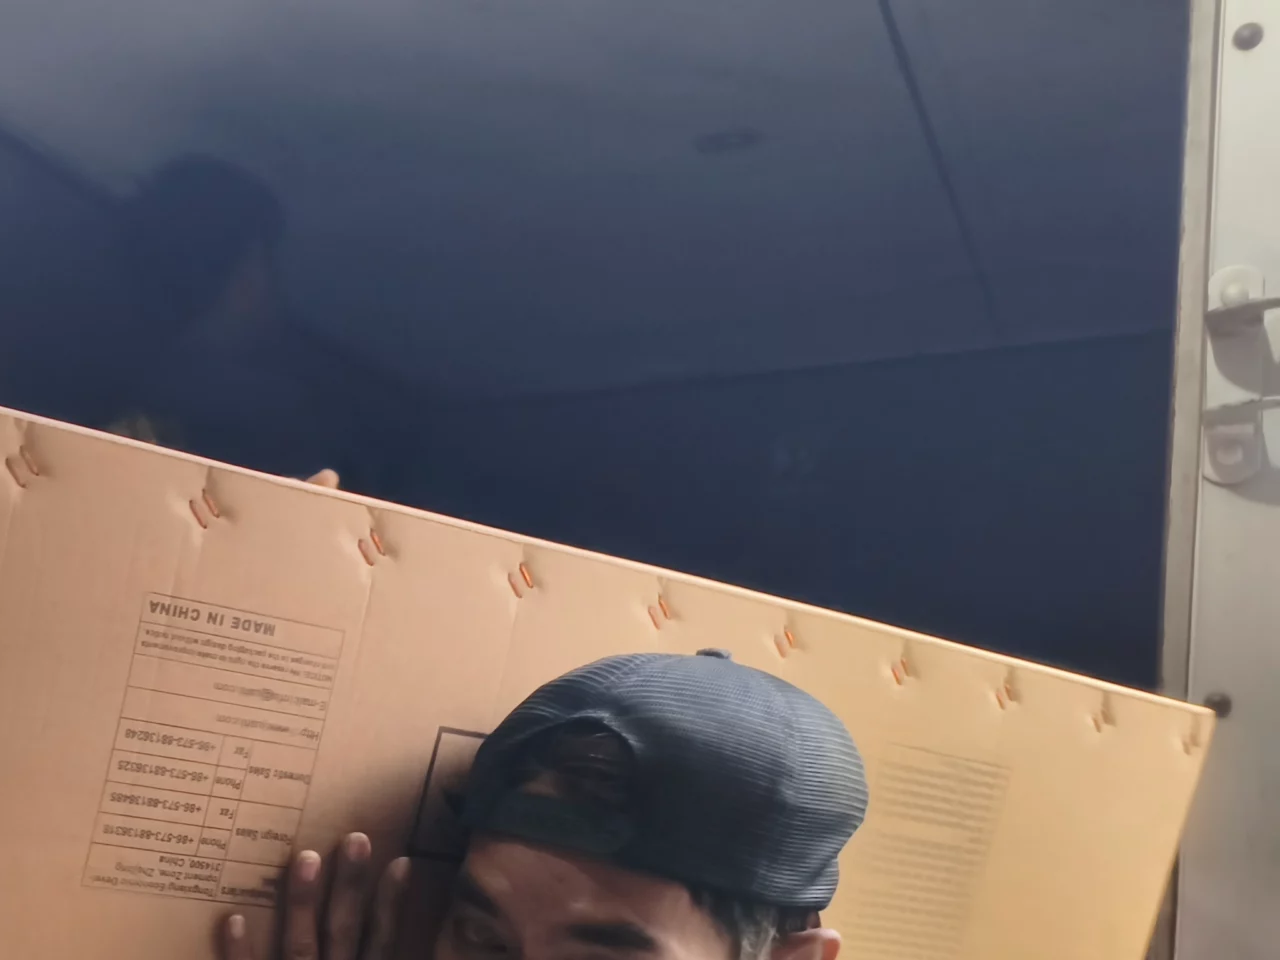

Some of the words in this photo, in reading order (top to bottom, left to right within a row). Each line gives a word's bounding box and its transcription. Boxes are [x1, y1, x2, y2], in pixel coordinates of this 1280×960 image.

[148, 599, 200, 621] CHINA
[205, 611, 225, 626] IN
[231, 616, 275, 636] MADE
[232, 745, 249, 758] Fax
[247, 765, 271, 778] Sales
[272, 769, 309, 784] Domestic
[213, 775, 241, 789] Phone
[218, 807, 234, 818] Fax
[234, 827, 259, 840] Sales
[199, 836, 227, 849] Phone
[157, 855, 185, 867] China
